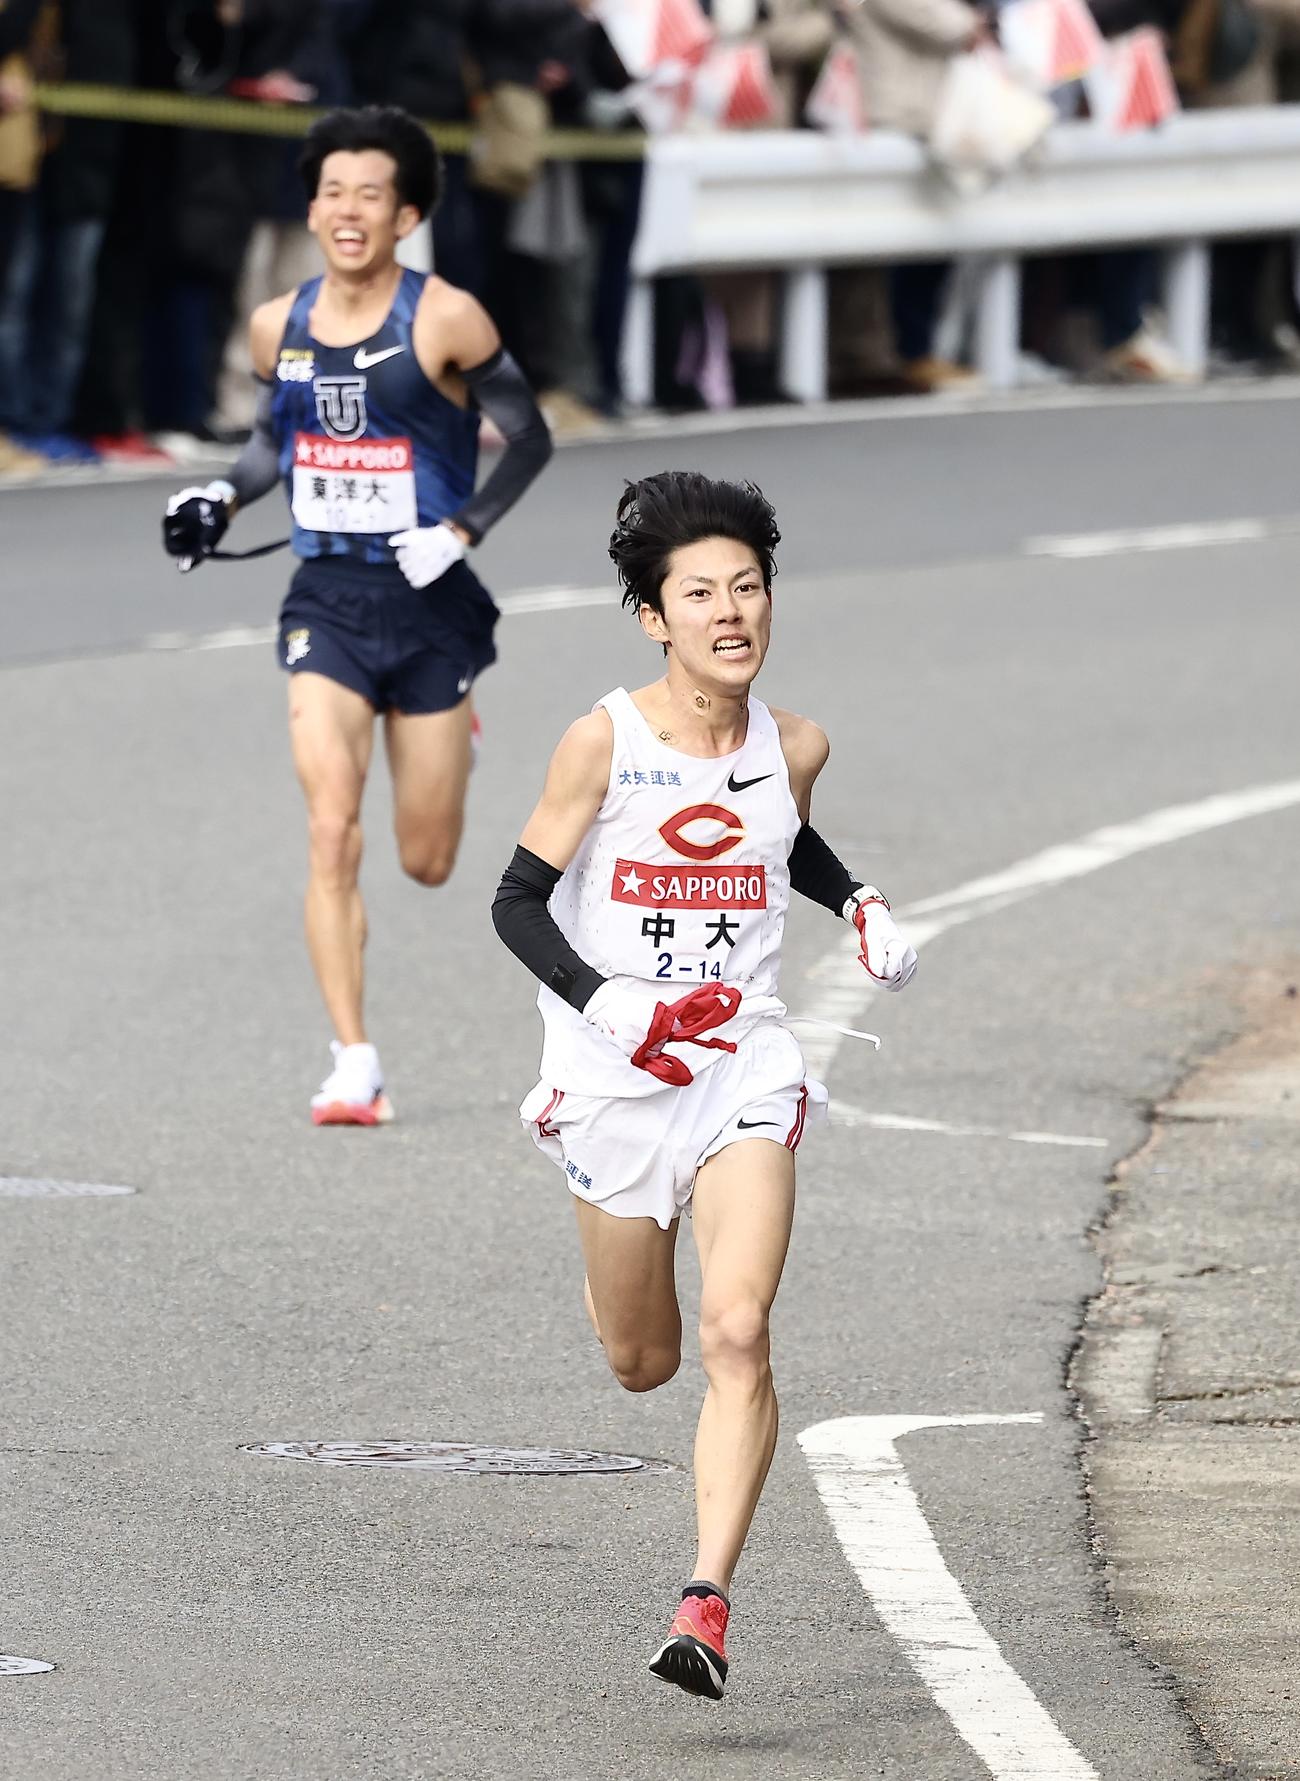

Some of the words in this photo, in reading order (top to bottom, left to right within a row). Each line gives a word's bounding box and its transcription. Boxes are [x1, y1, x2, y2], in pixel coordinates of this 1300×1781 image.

[312, 443, 408, 469] SAPPORO
[311, 476, 389, 505] 東洋大
[618, 769, 682, 787] 大矢運送
[658, 803, 746, 861] C
[650, 875, 762, 901] SAPPORO
[655, 952, 721, 980] 2-14
